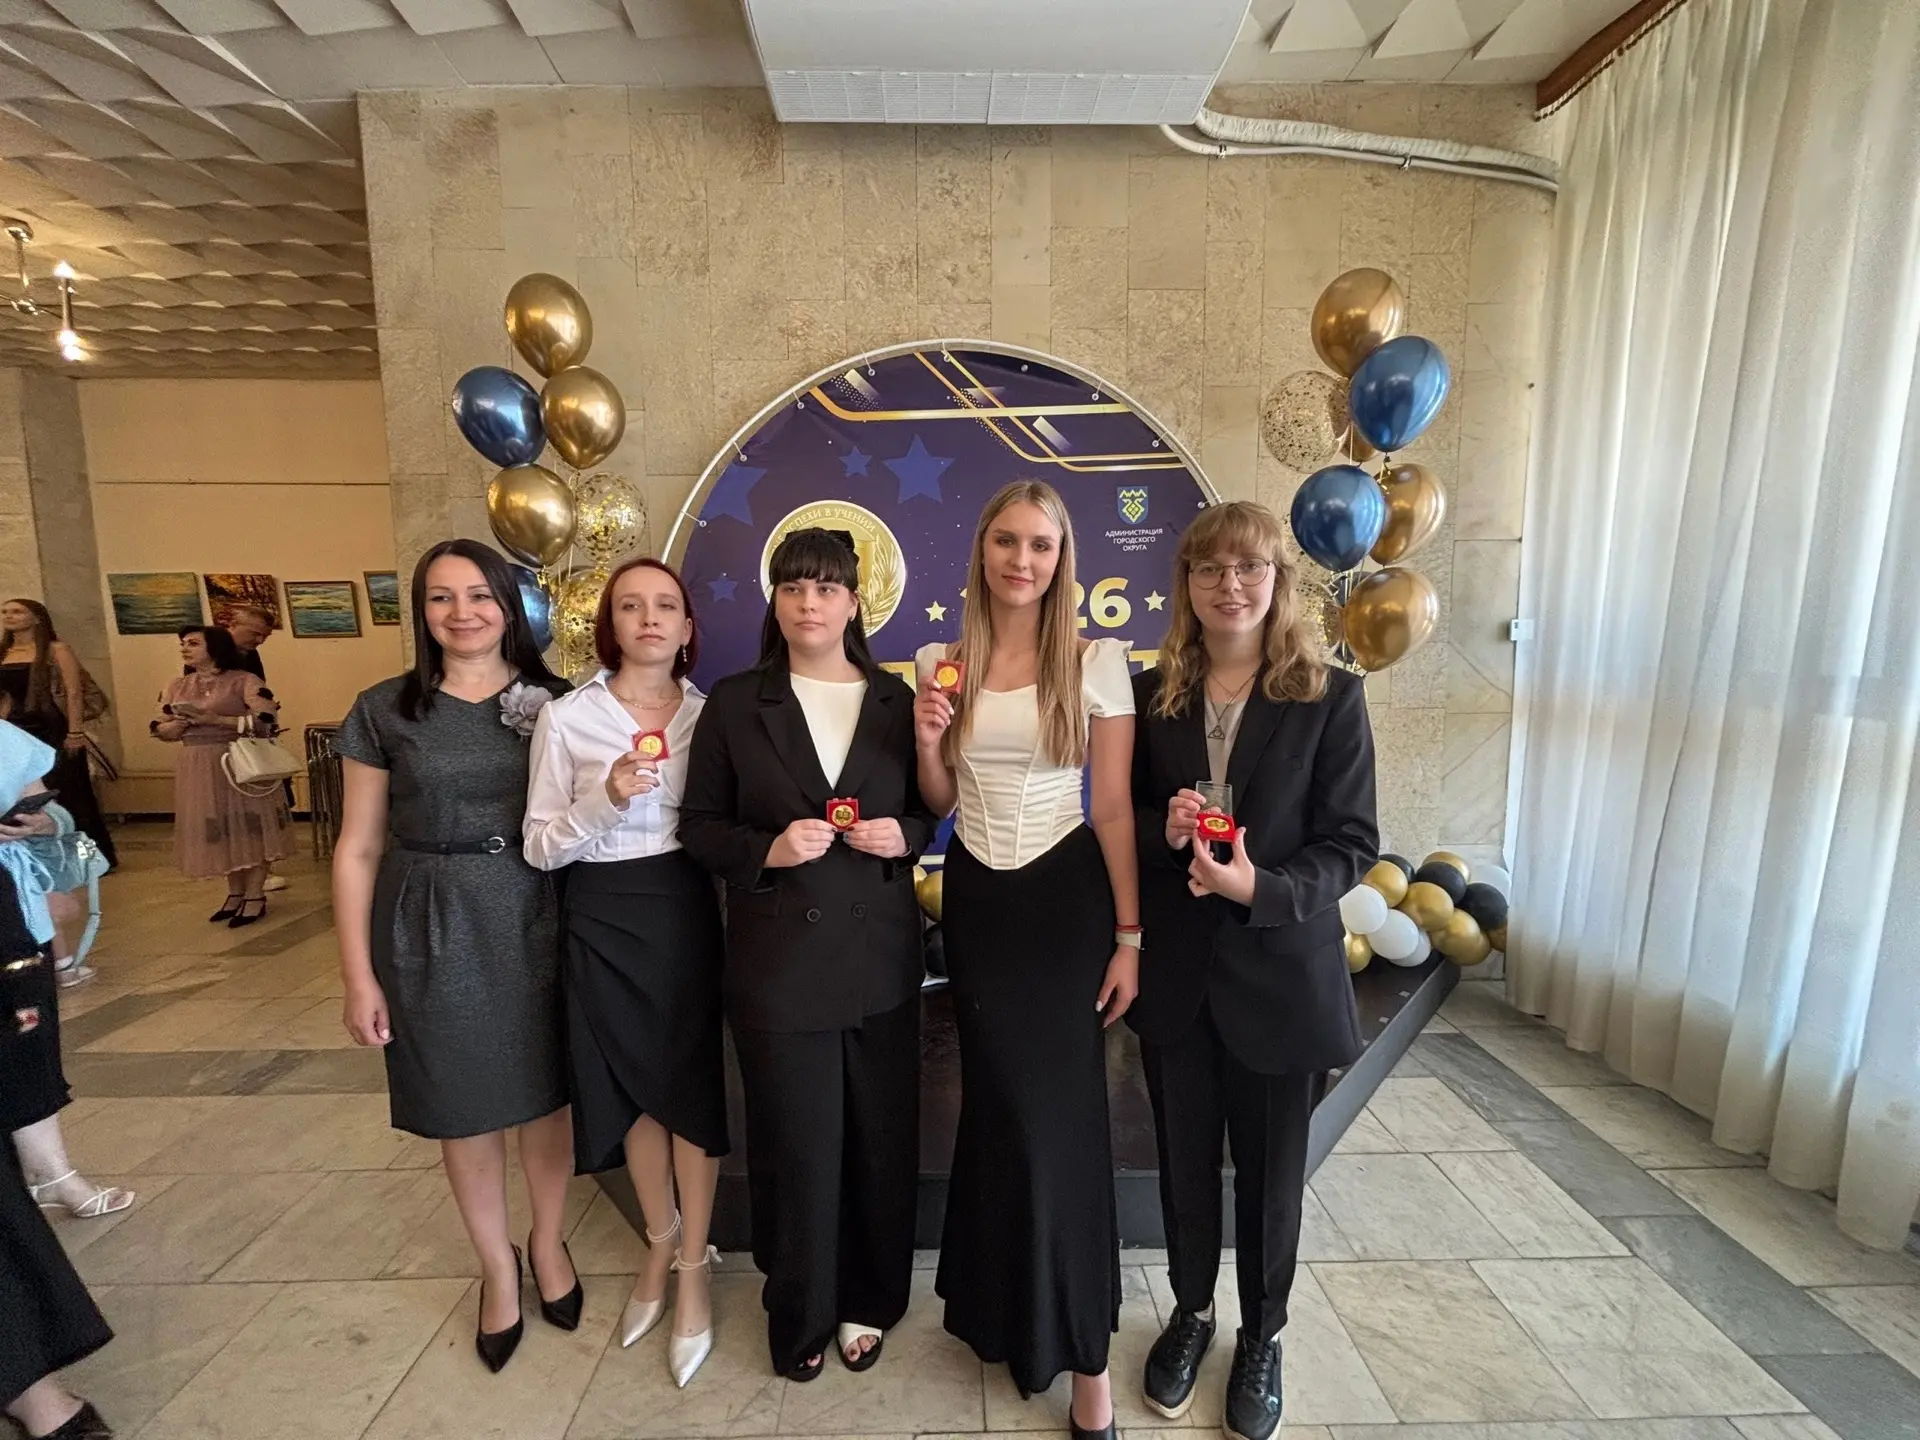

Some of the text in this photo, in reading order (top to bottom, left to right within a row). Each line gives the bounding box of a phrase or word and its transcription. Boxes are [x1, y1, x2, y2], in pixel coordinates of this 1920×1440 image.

[824, 508, 832, 517] В
[834, 508, 875, 532] УЧЕНИИ
[1105, 528, 1163, 538] АДМИНИСТРАЦИЯ
[1113, 536, 1156, 545] ГОРОДСКОГО
[1122, 544, 1147, 552] ОКРУГА
